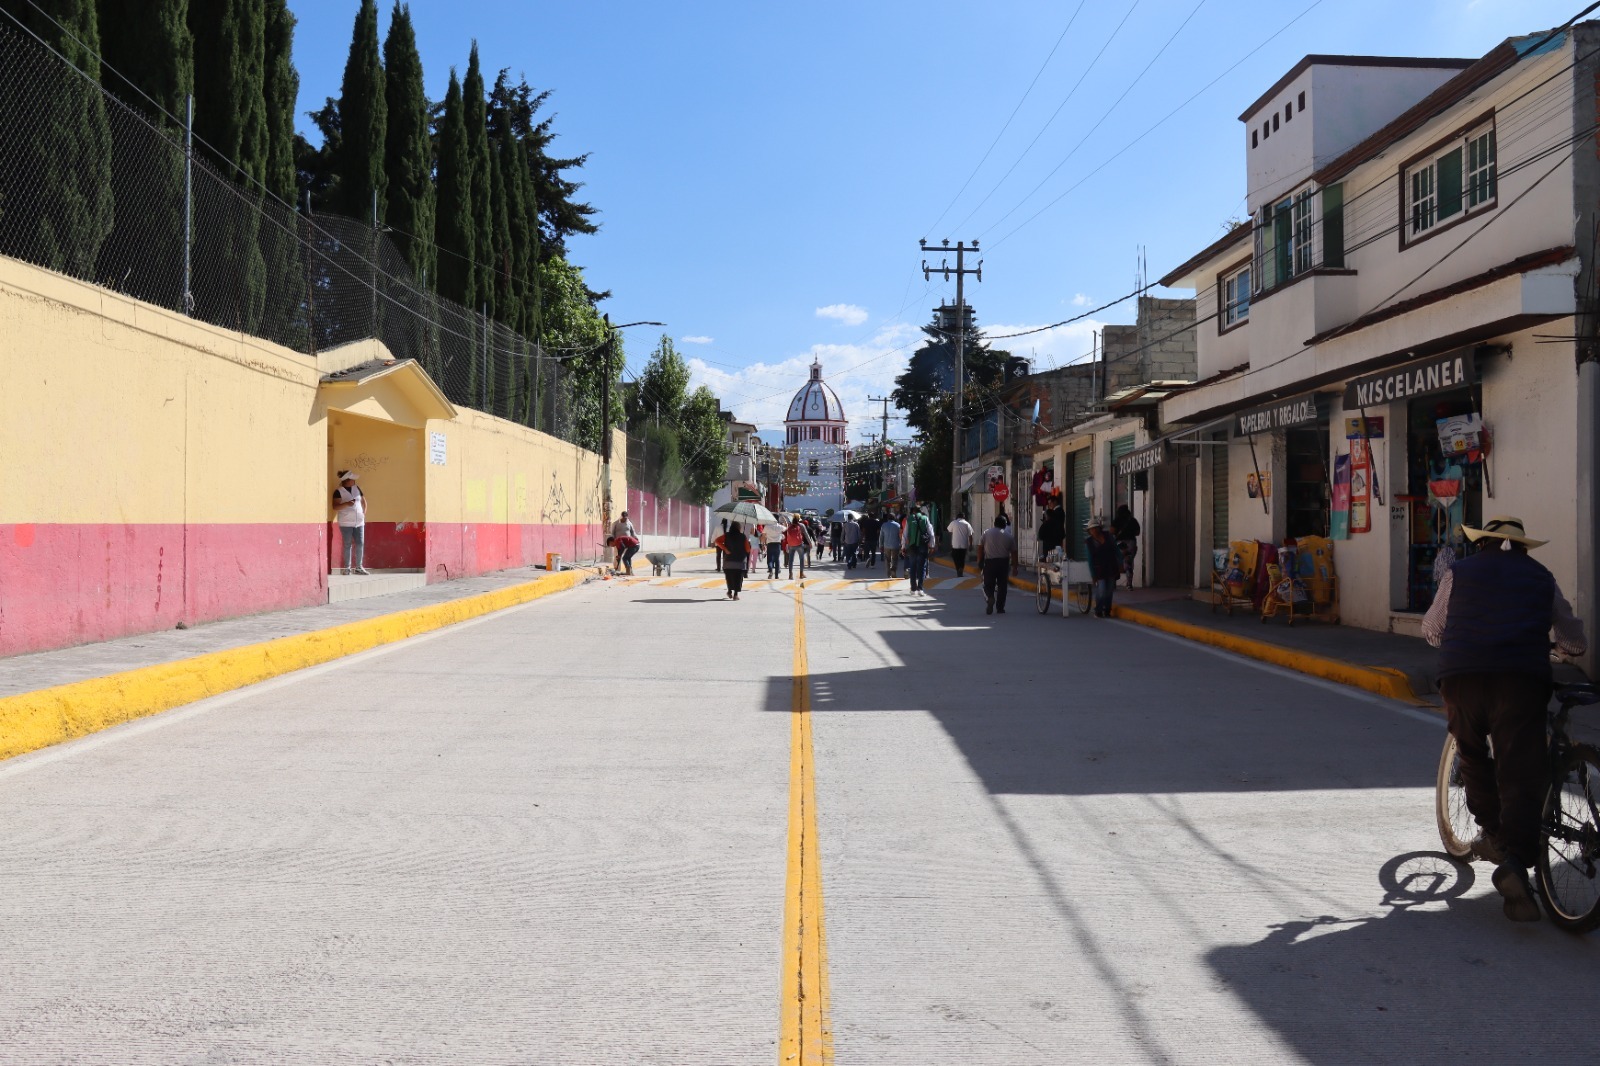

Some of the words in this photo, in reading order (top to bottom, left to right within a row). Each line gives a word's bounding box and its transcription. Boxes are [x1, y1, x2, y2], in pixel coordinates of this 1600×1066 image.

[1356, 357, 1465, 407] MISCELANEA
[1273, 408, 1278, 427] Y
[1119, 446, 1162, 475] FLORISTERIA
